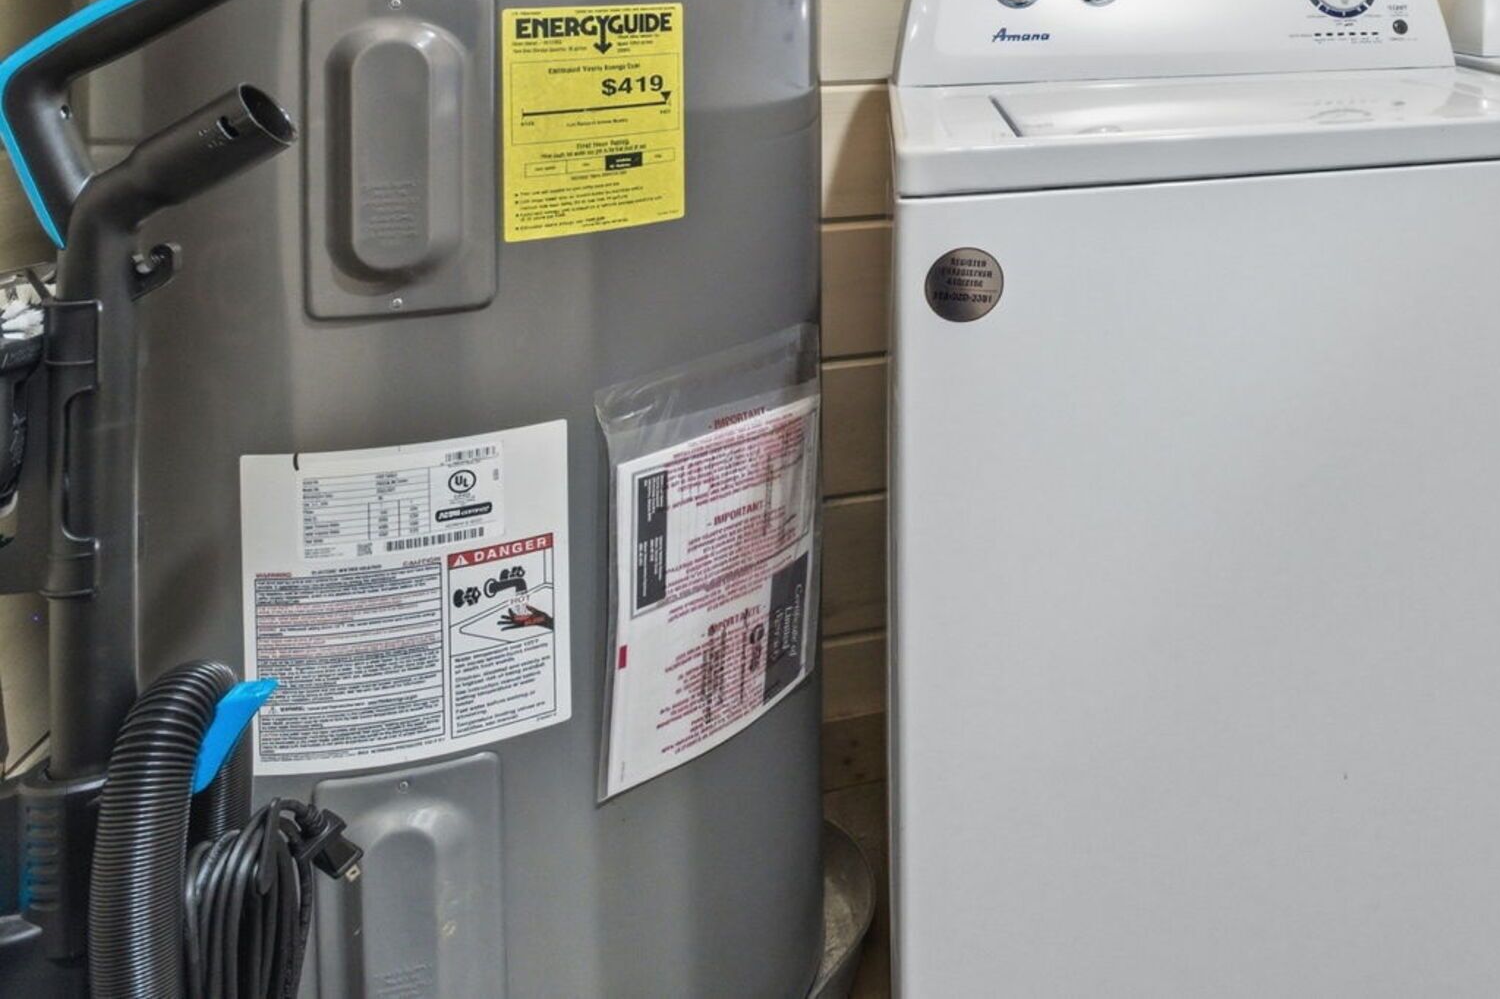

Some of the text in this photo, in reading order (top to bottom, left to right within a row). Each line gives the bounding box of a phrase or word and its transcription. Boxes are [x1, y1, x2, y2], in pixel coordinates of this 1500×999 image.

[992, 27, 1051, 43] Amana
[601, 74, 664, 97] $419
[474, 537, 549, 563] DANGER
